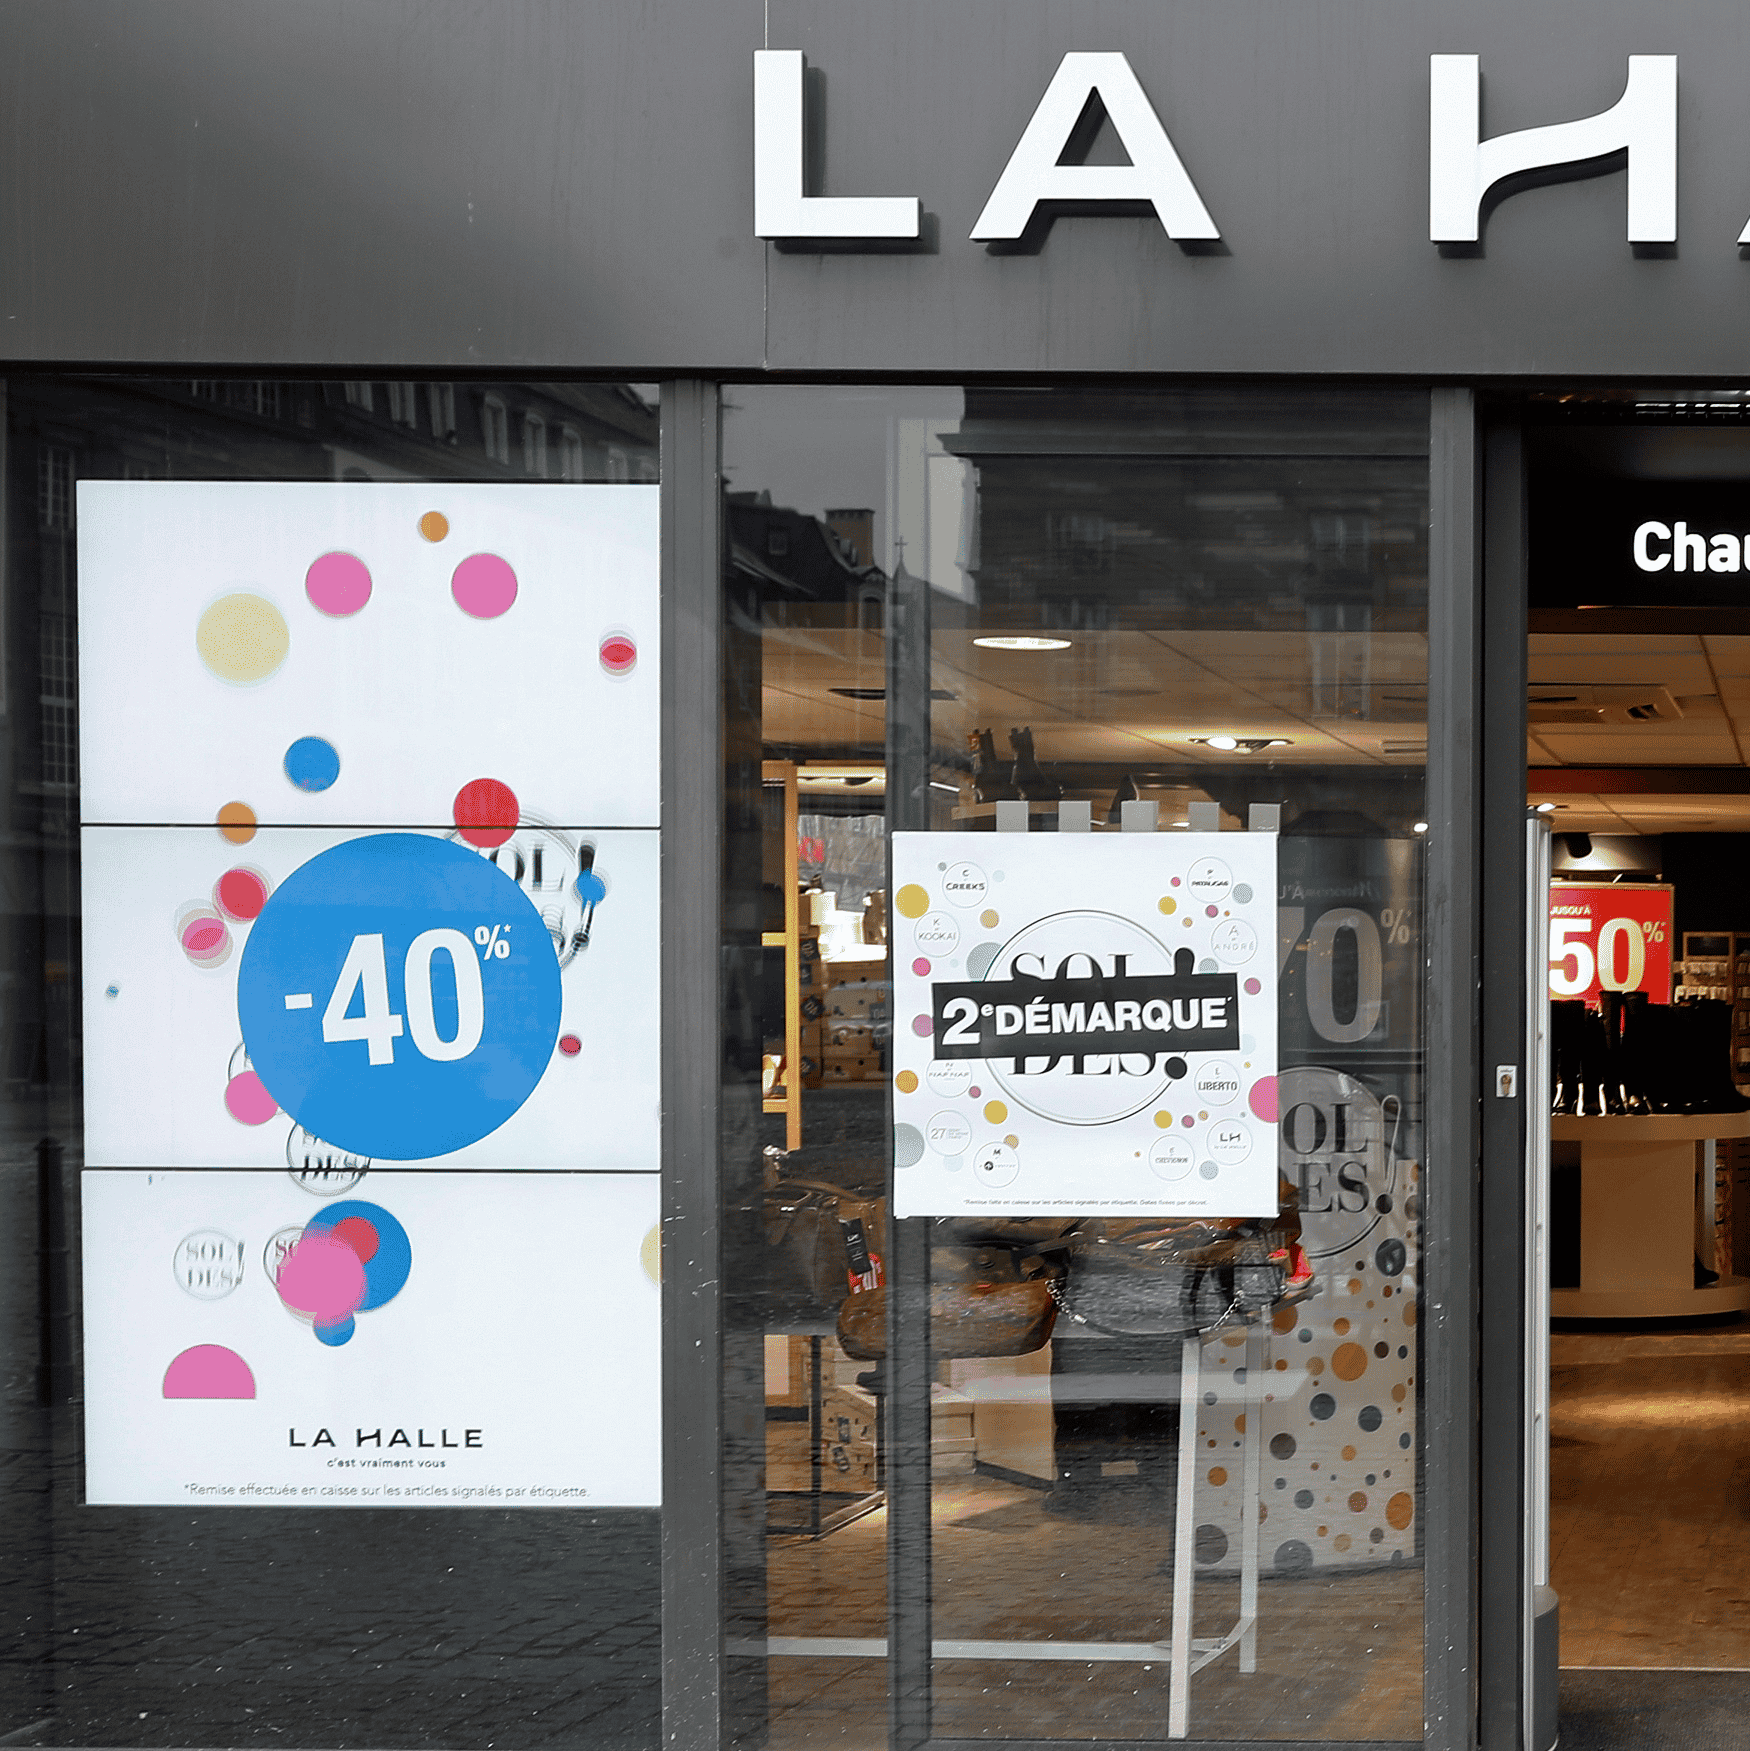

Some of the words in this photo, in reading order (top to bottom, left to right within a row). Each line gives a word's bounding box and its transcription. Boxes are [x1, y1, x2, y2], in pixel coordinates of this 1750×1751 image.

[754, 50, 1221, 243] LA
[1198, 1081, 1238, 1090] LIBERTO
[1282, 1102, 1368, 1154] OL
[1293, 1161, 1369, 1213] ES
[289, 1428, 336, 1447] LA
[357, 1428, 483, 1448] HALLE
[360, 1458, 414, 1468] vraiment
[417, 1460, 446, 1468] vous
[301, 1486, 315, 1495] en
[320, 1484, 358, 1495] caisse
[361, 1486, 380, 1495] sur
[384, 1484, 400, 1496] les
[404, 1484, 449, 1496] articles
